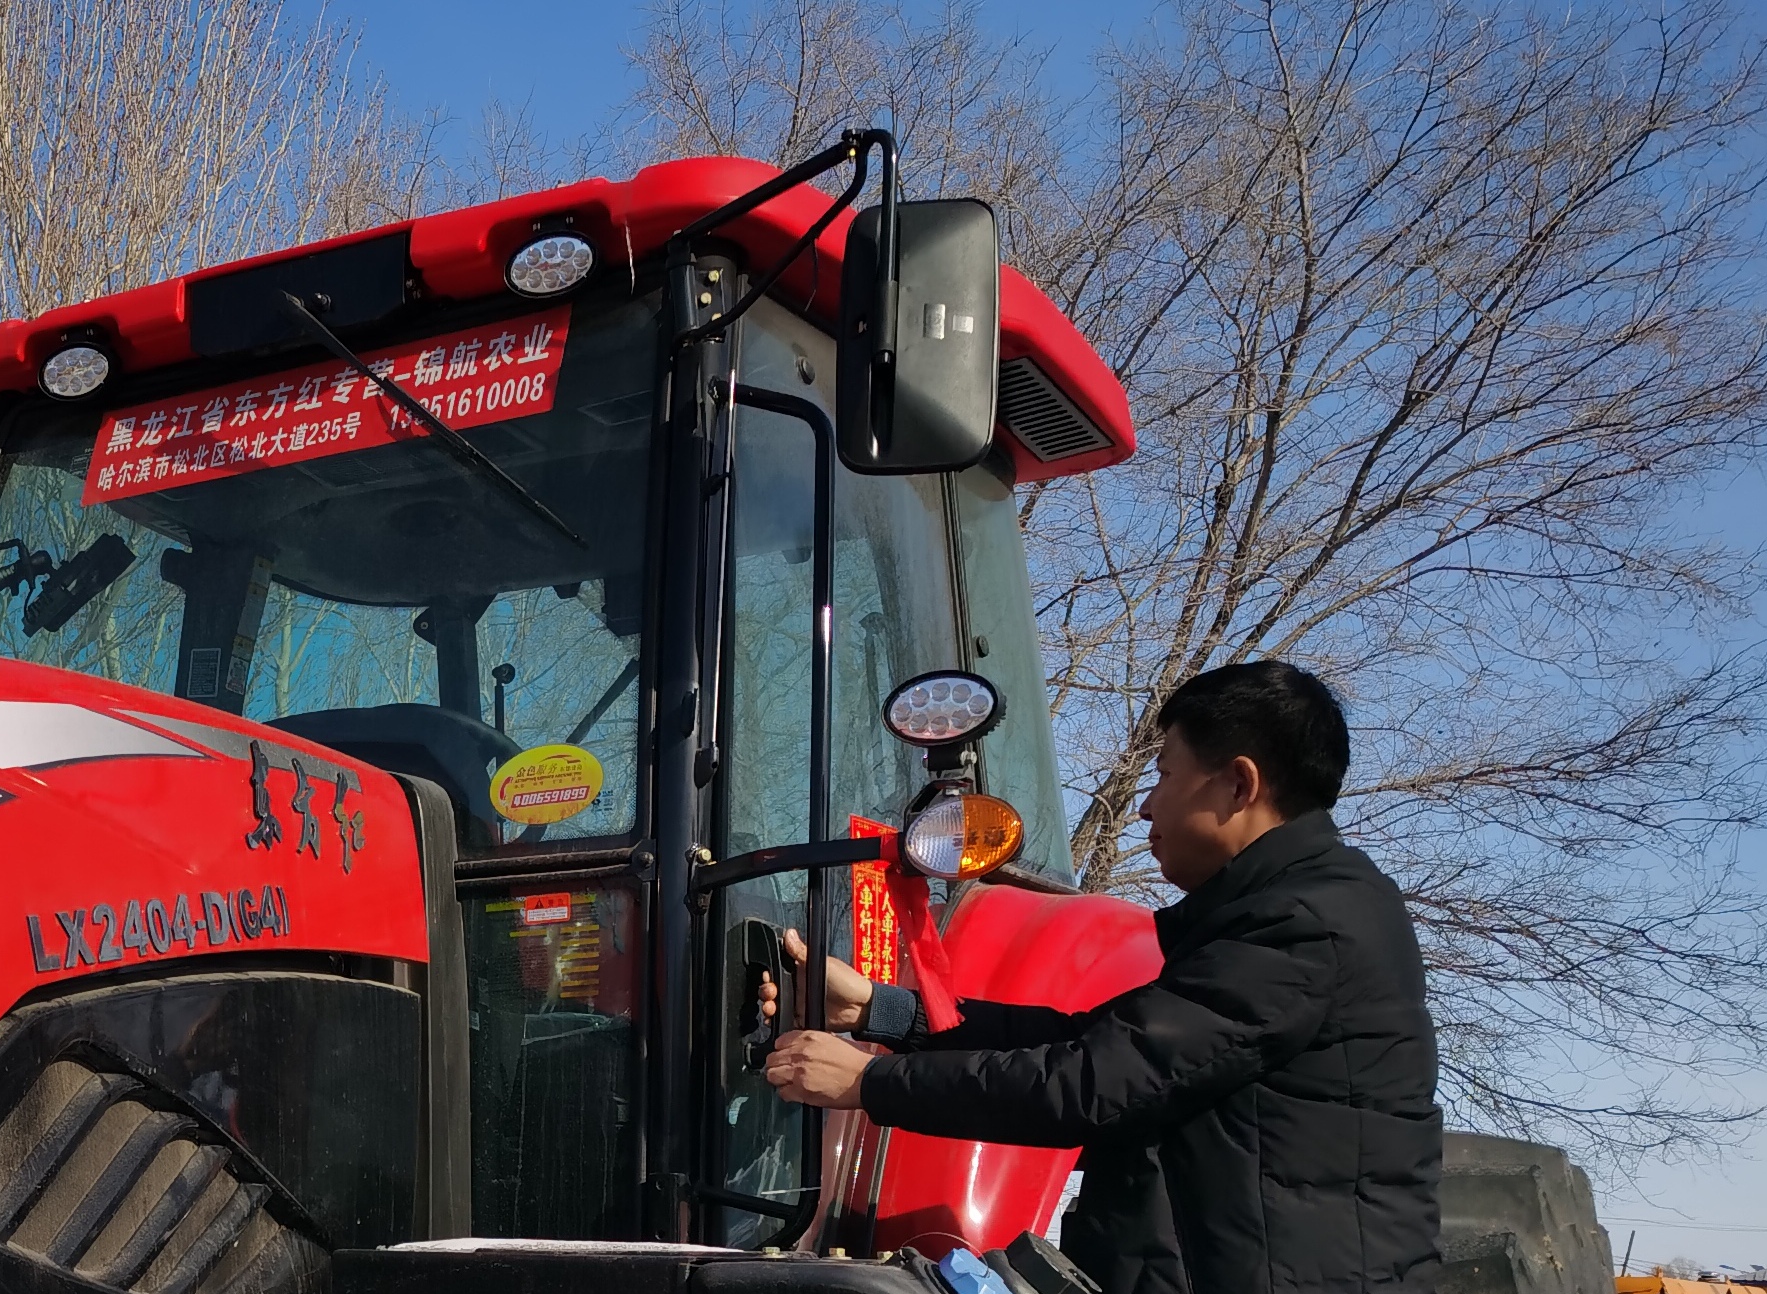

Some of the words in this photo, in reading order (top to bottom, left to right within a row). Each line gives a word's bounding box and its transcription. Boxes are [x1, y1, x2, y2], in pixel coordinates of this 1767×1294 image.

[98, 412, 363, 492] 哈尔滨市松北区松北大道235号
[514, 788, 587, 807] 4006591899
[28, 885, 291, 973] LX2404-D(G4)
